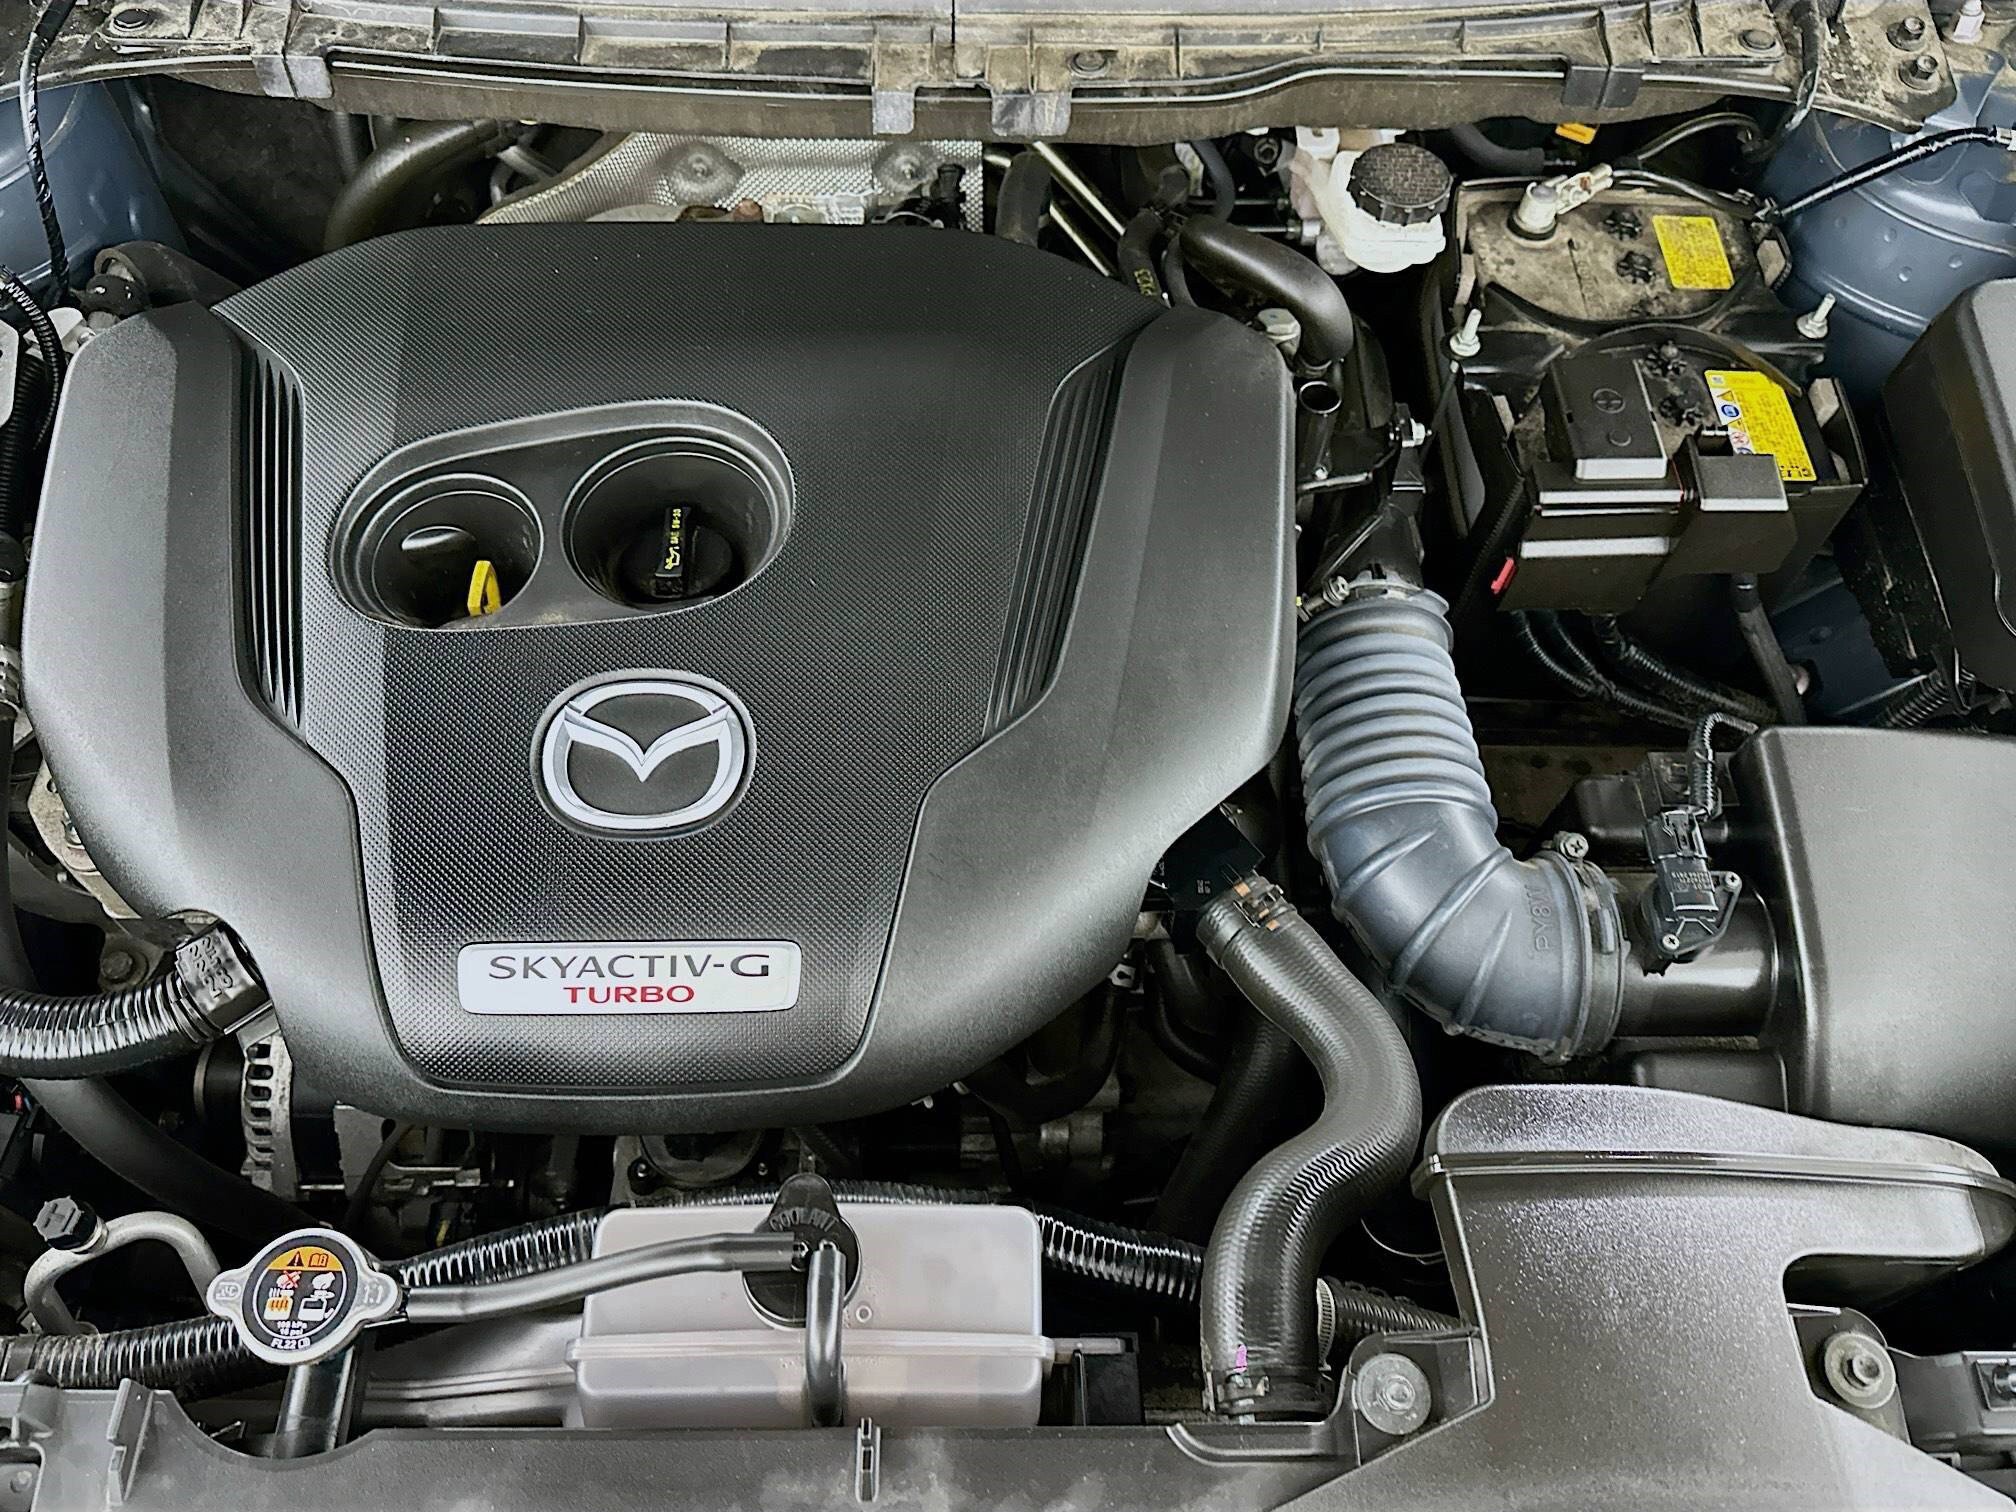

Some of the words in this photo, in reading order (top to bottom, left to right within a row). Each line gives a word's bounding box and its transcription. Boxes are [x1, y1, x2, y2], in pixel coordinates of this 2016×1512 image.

[488, 954, 770, 979] SKYACTIV-G
[563, 985, 696, 1004] TURBO
[769, 1206, 840, 1233] COOLANT
[270, 1337, 297, 1350] FL22
